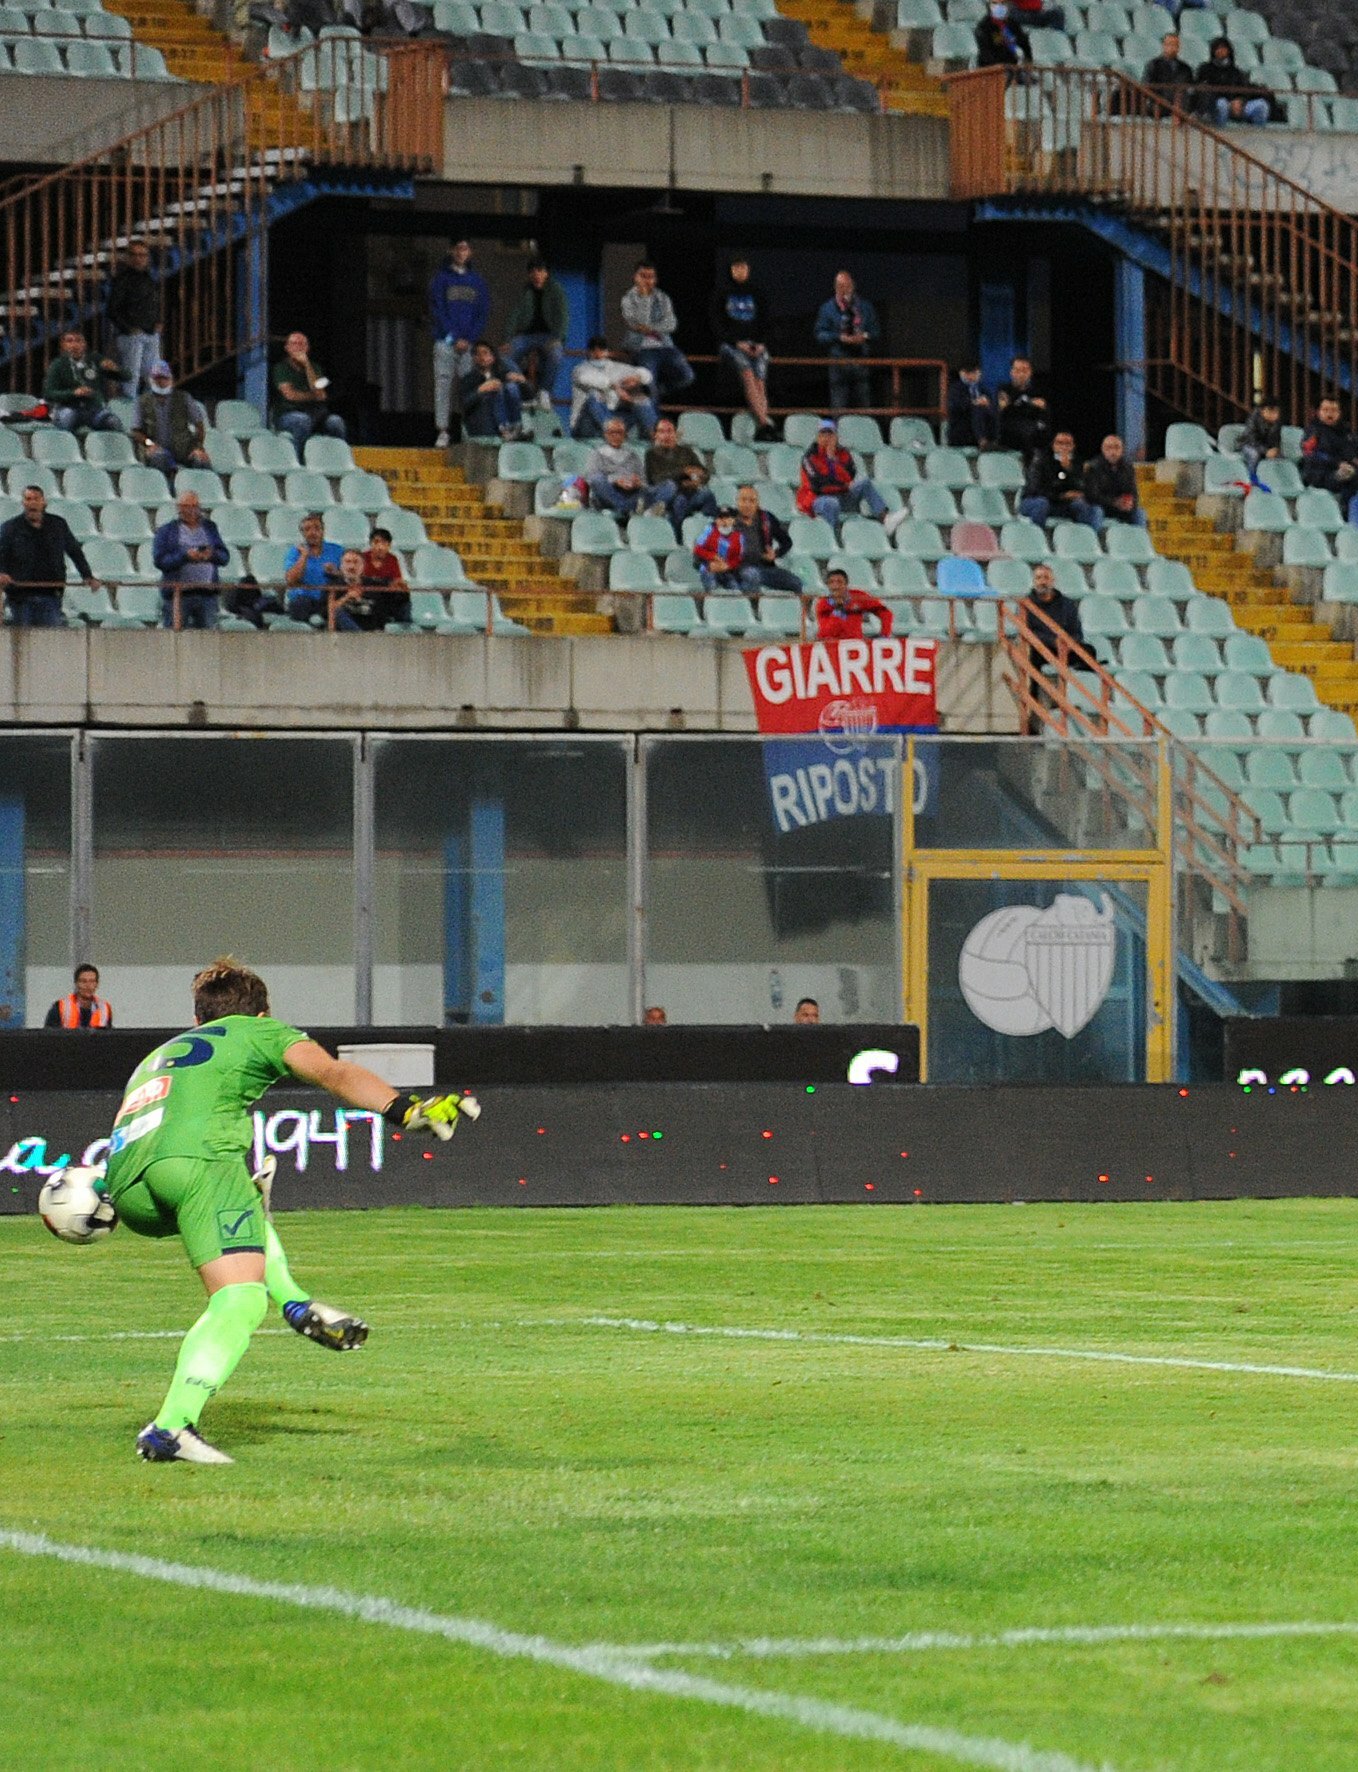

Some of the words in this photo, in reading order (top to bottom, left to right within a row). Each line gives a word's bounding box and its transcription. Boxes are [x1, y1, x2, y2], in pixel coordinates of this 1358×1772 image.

[755, 638, 935, 704] GIARRE
[770, 758, 928, 832] RIPOSTO
[252, 1109, 384, 1172] 1947
